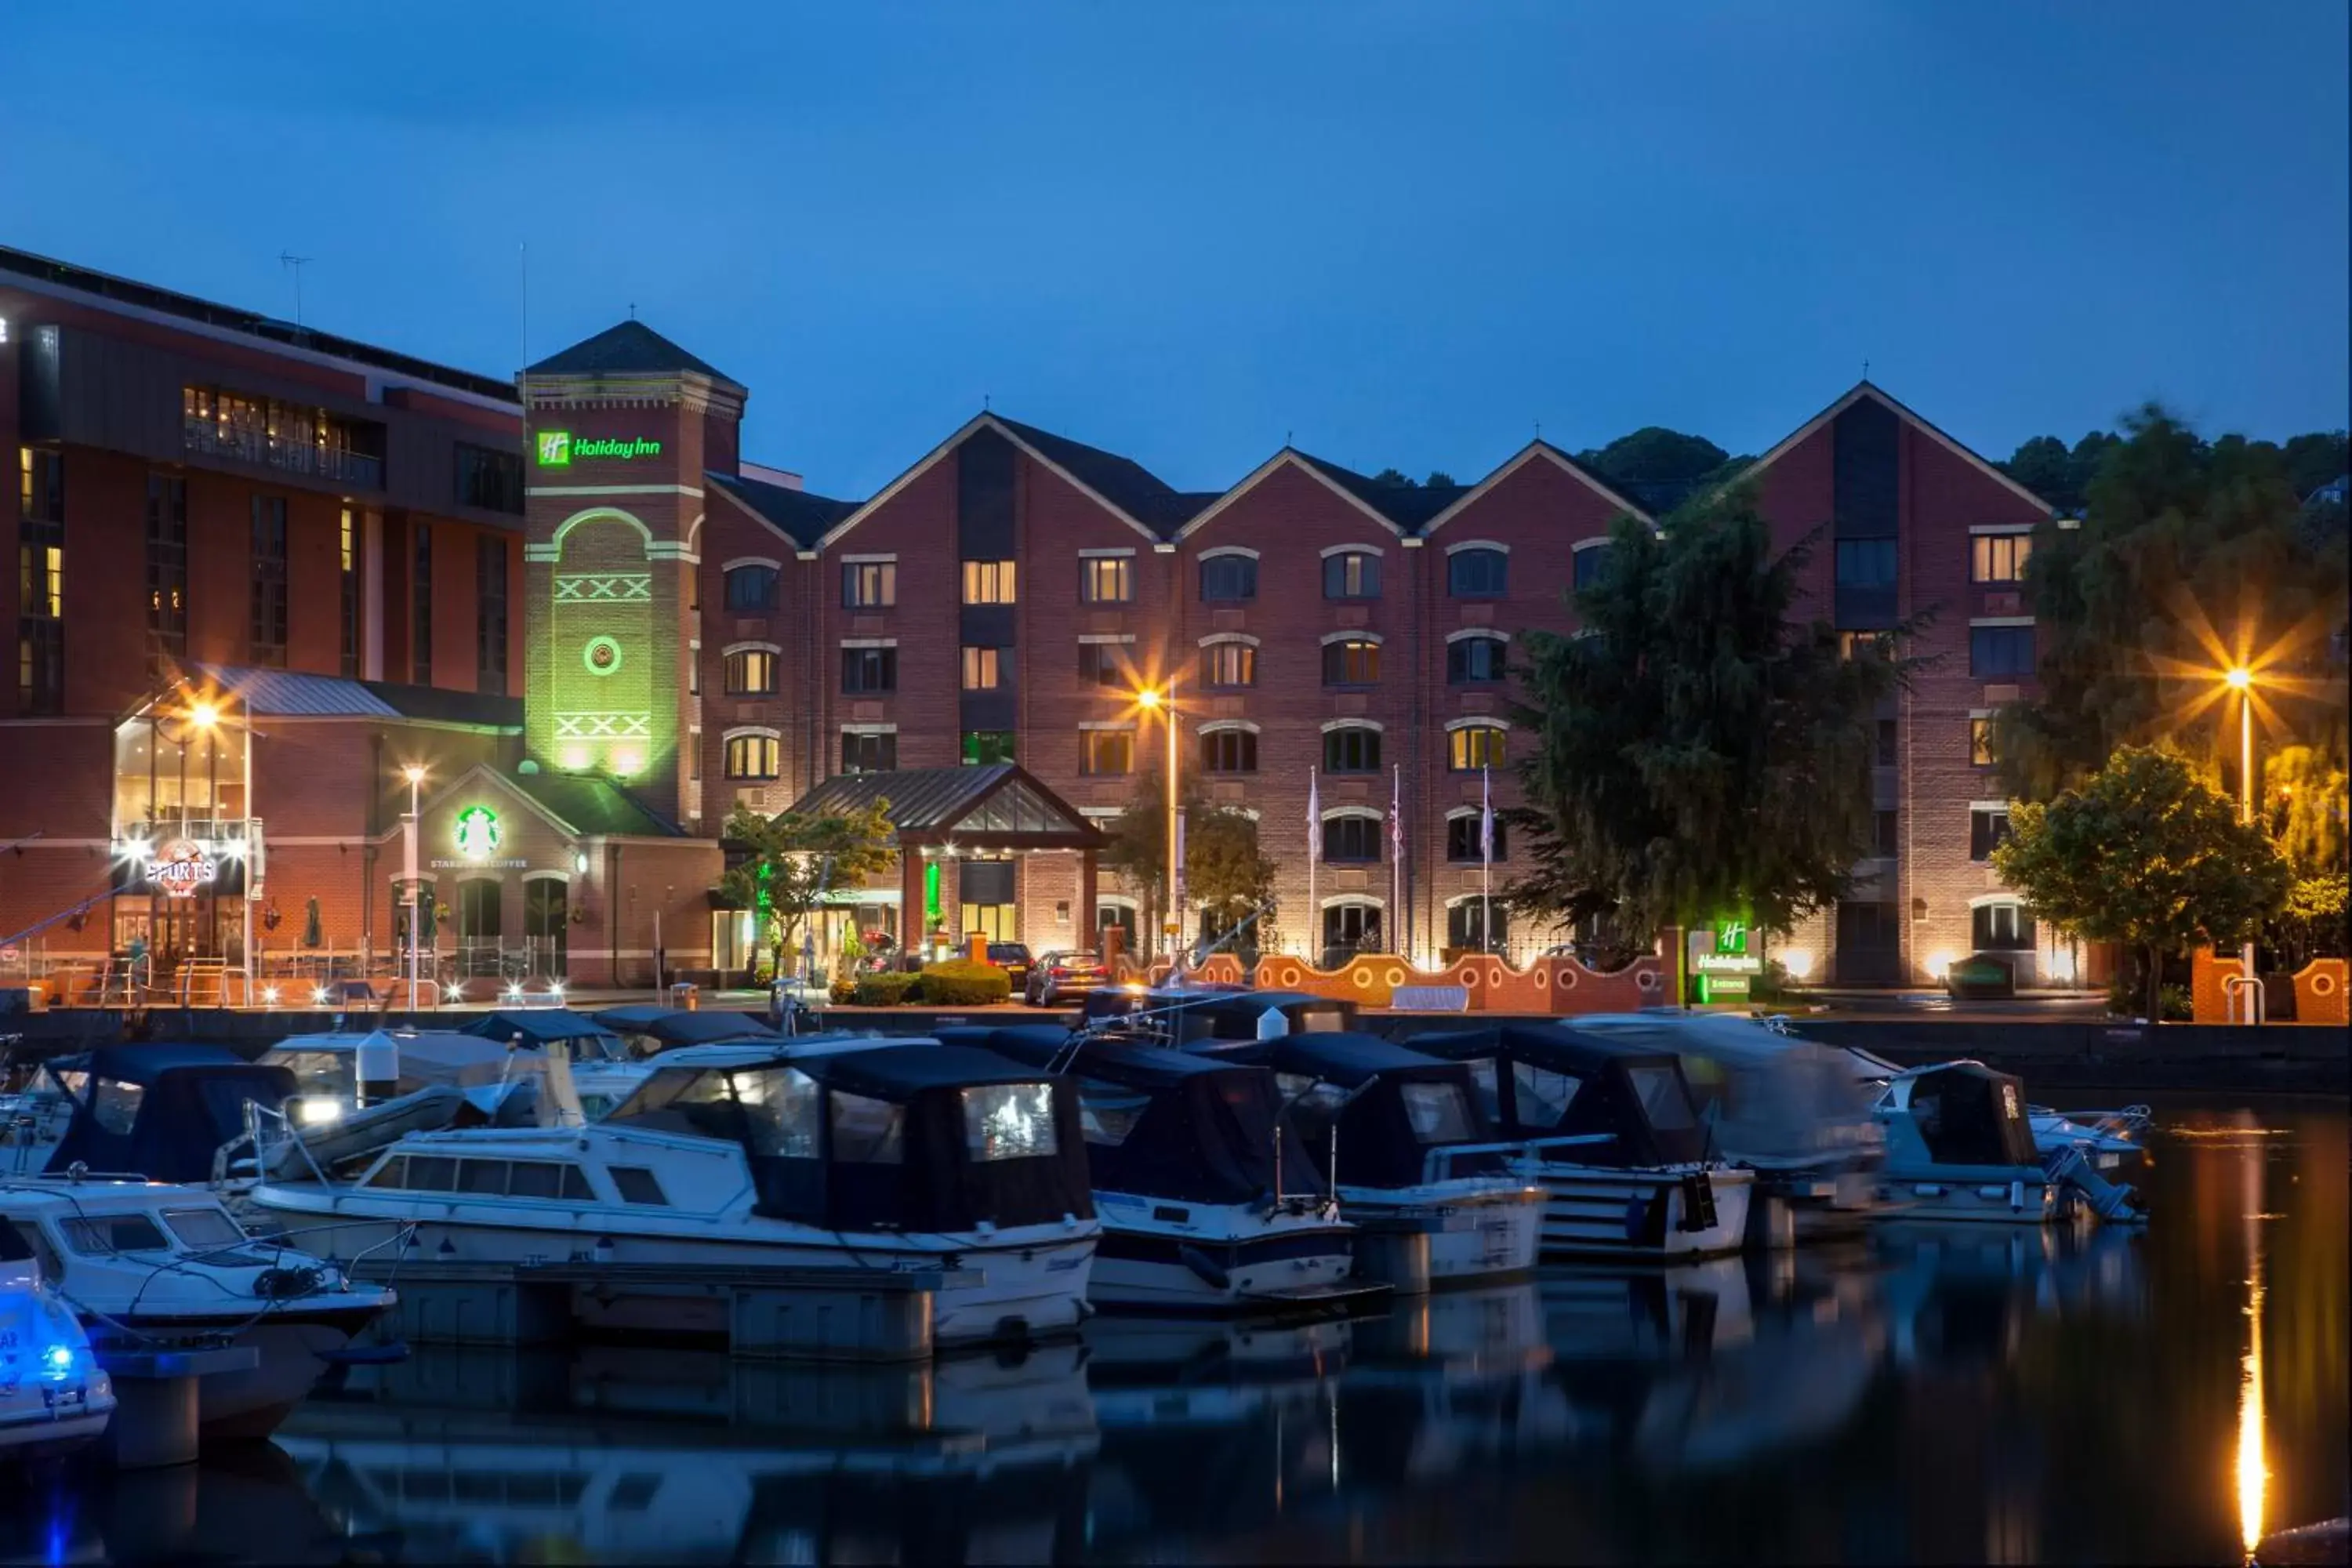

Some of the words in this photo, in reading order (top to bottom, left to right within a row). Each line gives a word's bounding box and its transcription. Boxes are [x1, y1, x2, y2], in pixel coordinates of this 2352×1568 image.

[575, 438, 633, 458] Holiday
[636, 437, 660, 454] Inn
[147, 862, 213, 881] SPORTS
[430, 859, 488, 868] STARBS
[490, 859, 528, 868] COFFEE
[1697, 953, 1742, 971] Holiday
